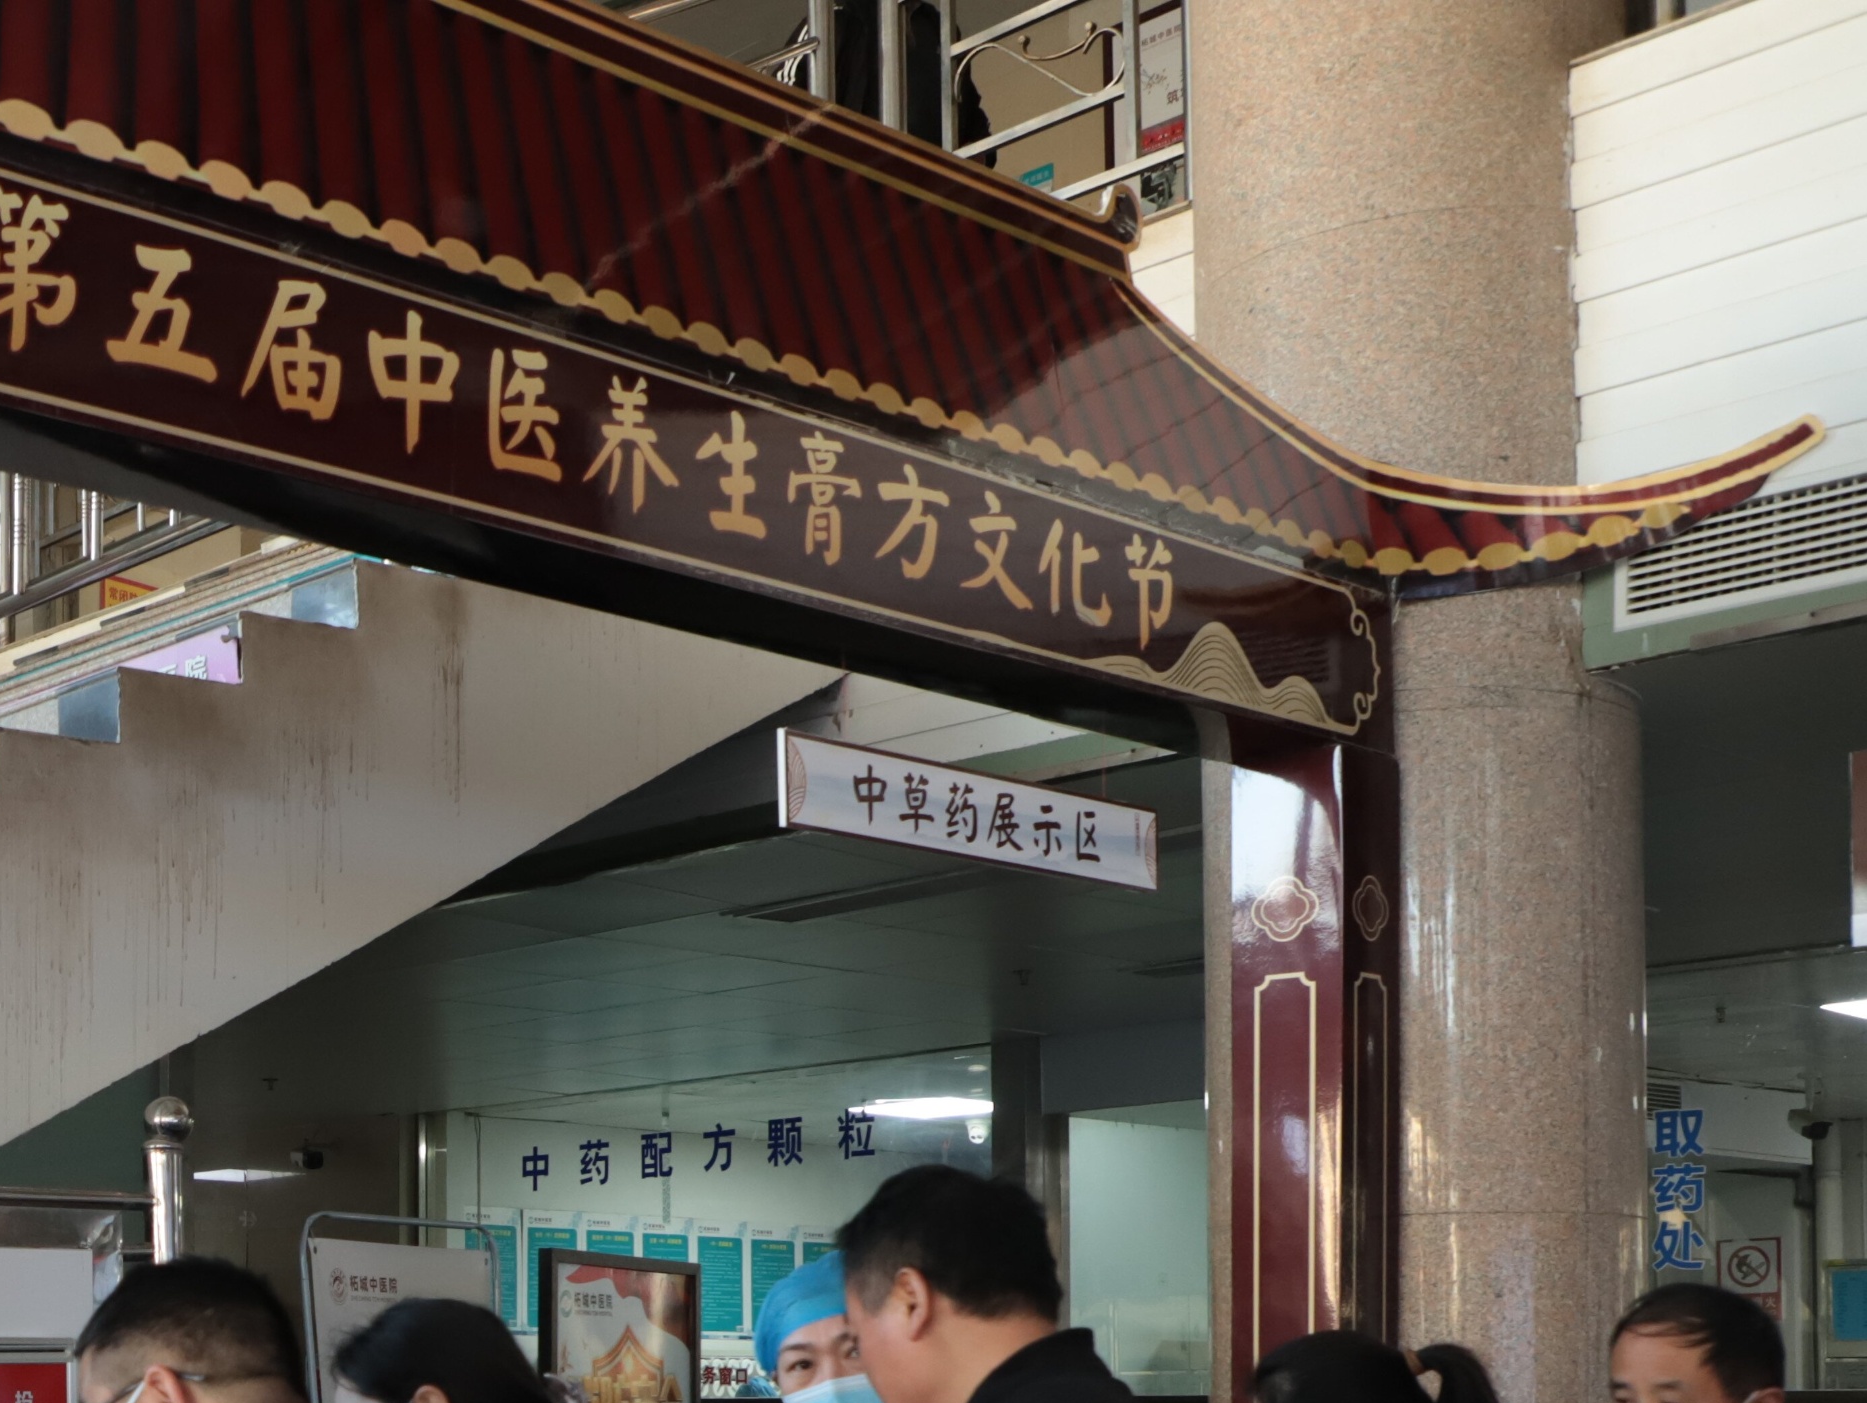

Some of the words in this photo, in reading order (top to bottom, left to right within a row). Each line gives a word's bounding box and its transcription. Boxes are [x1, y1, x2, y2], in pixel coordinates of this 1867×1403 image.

[852, 764, 1101, 863] 中草药展示区
[522, 1108, 876, 1191] 中药配方颗粒
[1653, 1108, 1705, 1272] 取药处
[700, 1366, 748, 1387] 务窗口
